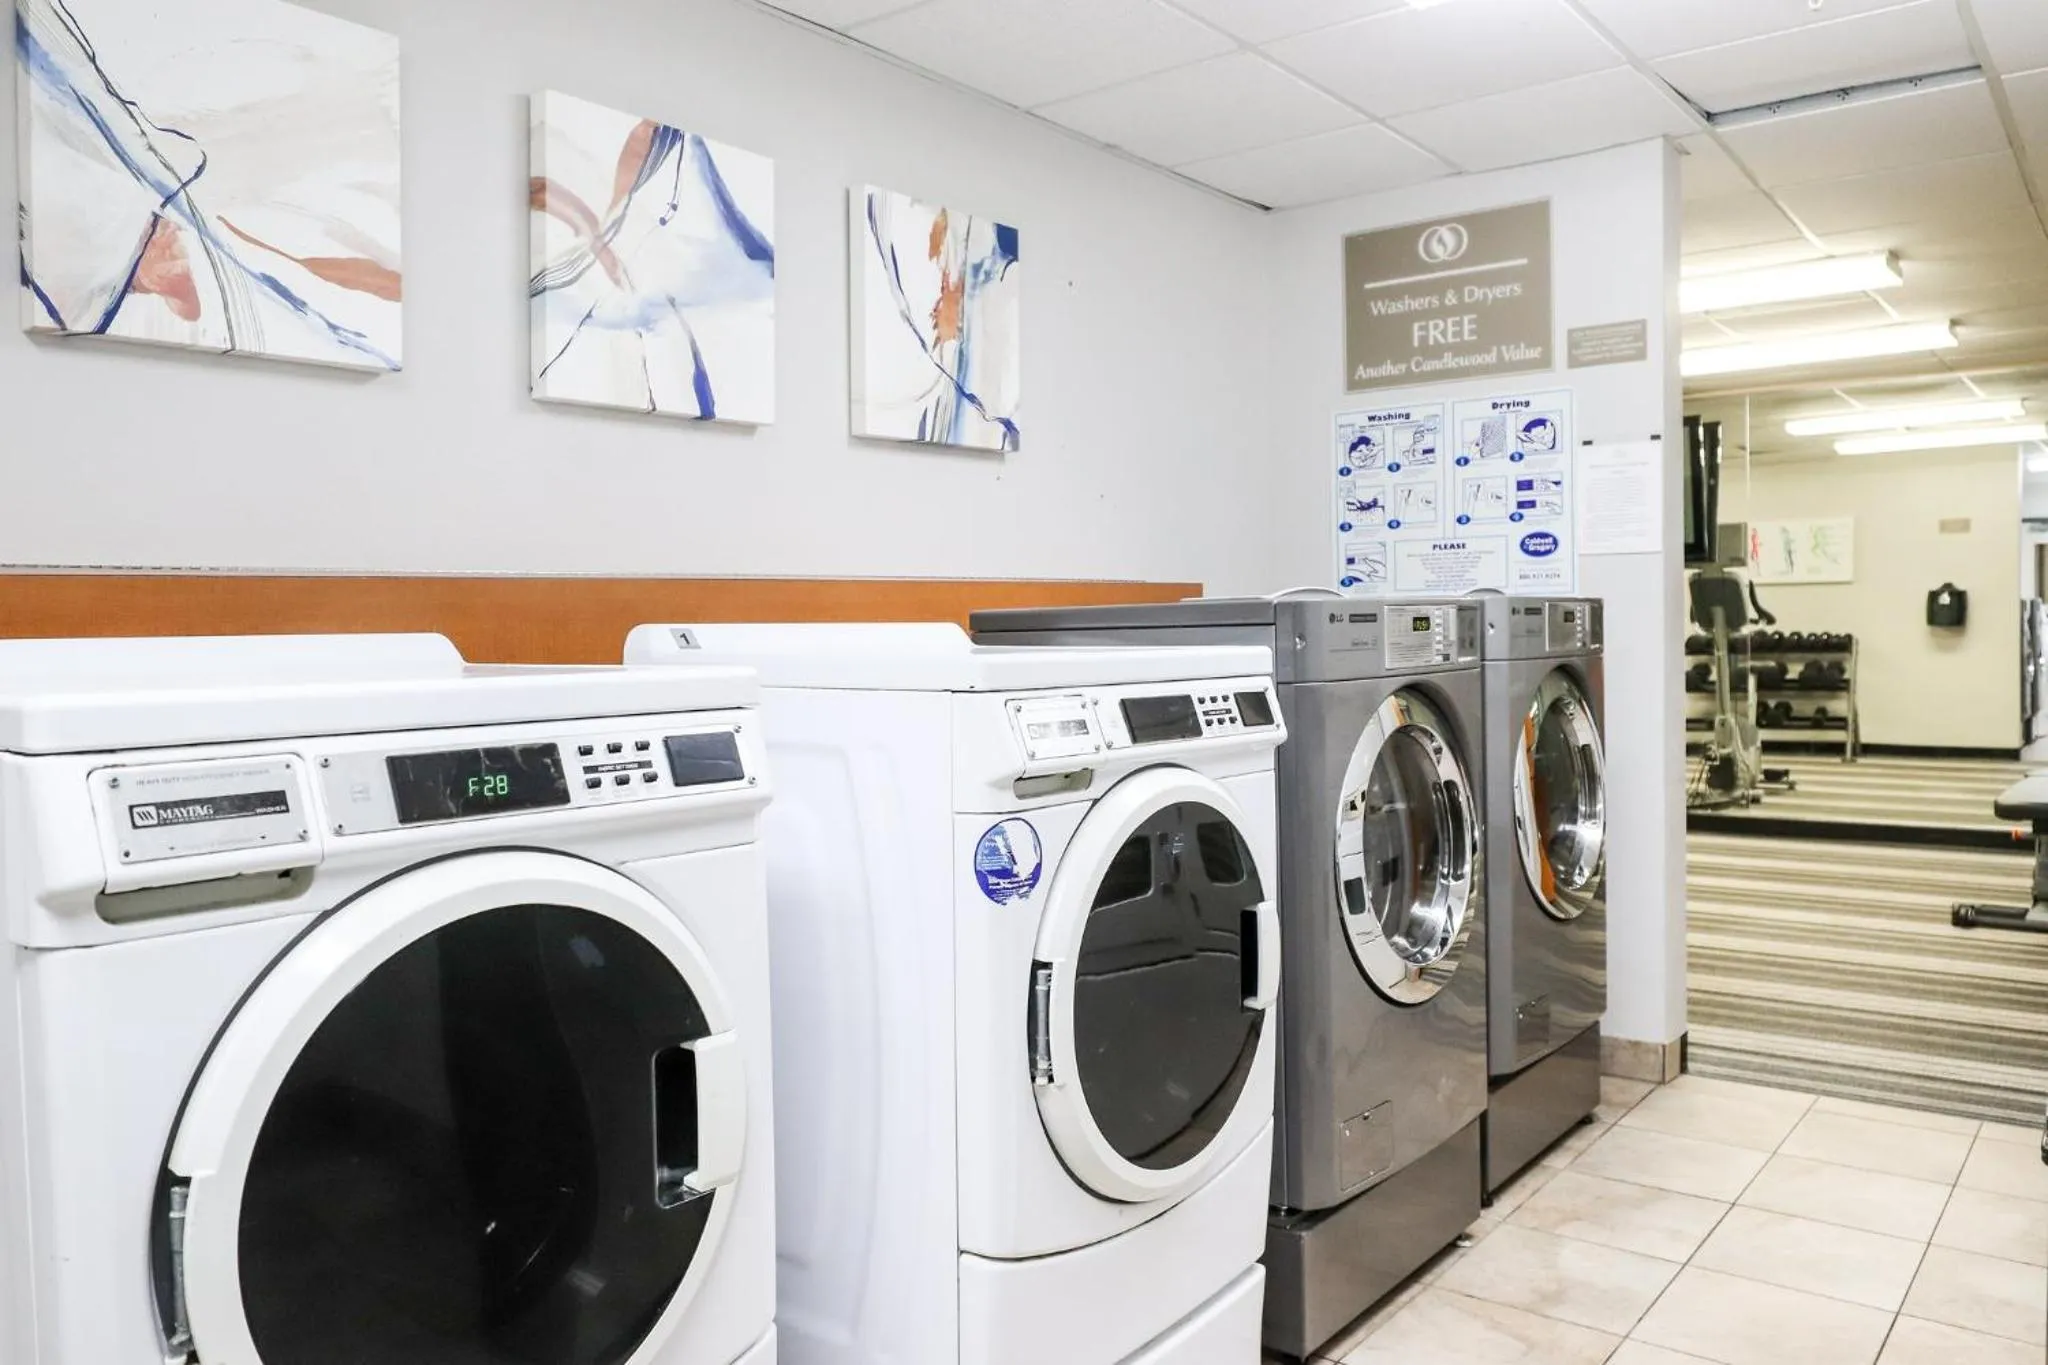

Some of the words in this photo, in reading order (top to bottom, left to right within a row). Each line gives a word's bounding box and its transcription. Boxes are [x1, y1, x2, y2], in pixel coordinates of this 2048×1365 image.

[1370, 294, 1440, 316] Washers
[1444, 289, 1458, 306] &
[1463, 283, 1522, 307] Dryers
[1412, 314, 1478, 348] FREE
[1354, 360, 1408, 380] Another
[1410, 345, 1498, 373] Candlewood
[1501, 341, 1543, 363] Value
[1491, 400, 1530, 410] Drying
[1367, 412, 1411, 422] Washing
[469, 775, 508, 797] F28
[158, 803, 214, 820] MAYTAG
